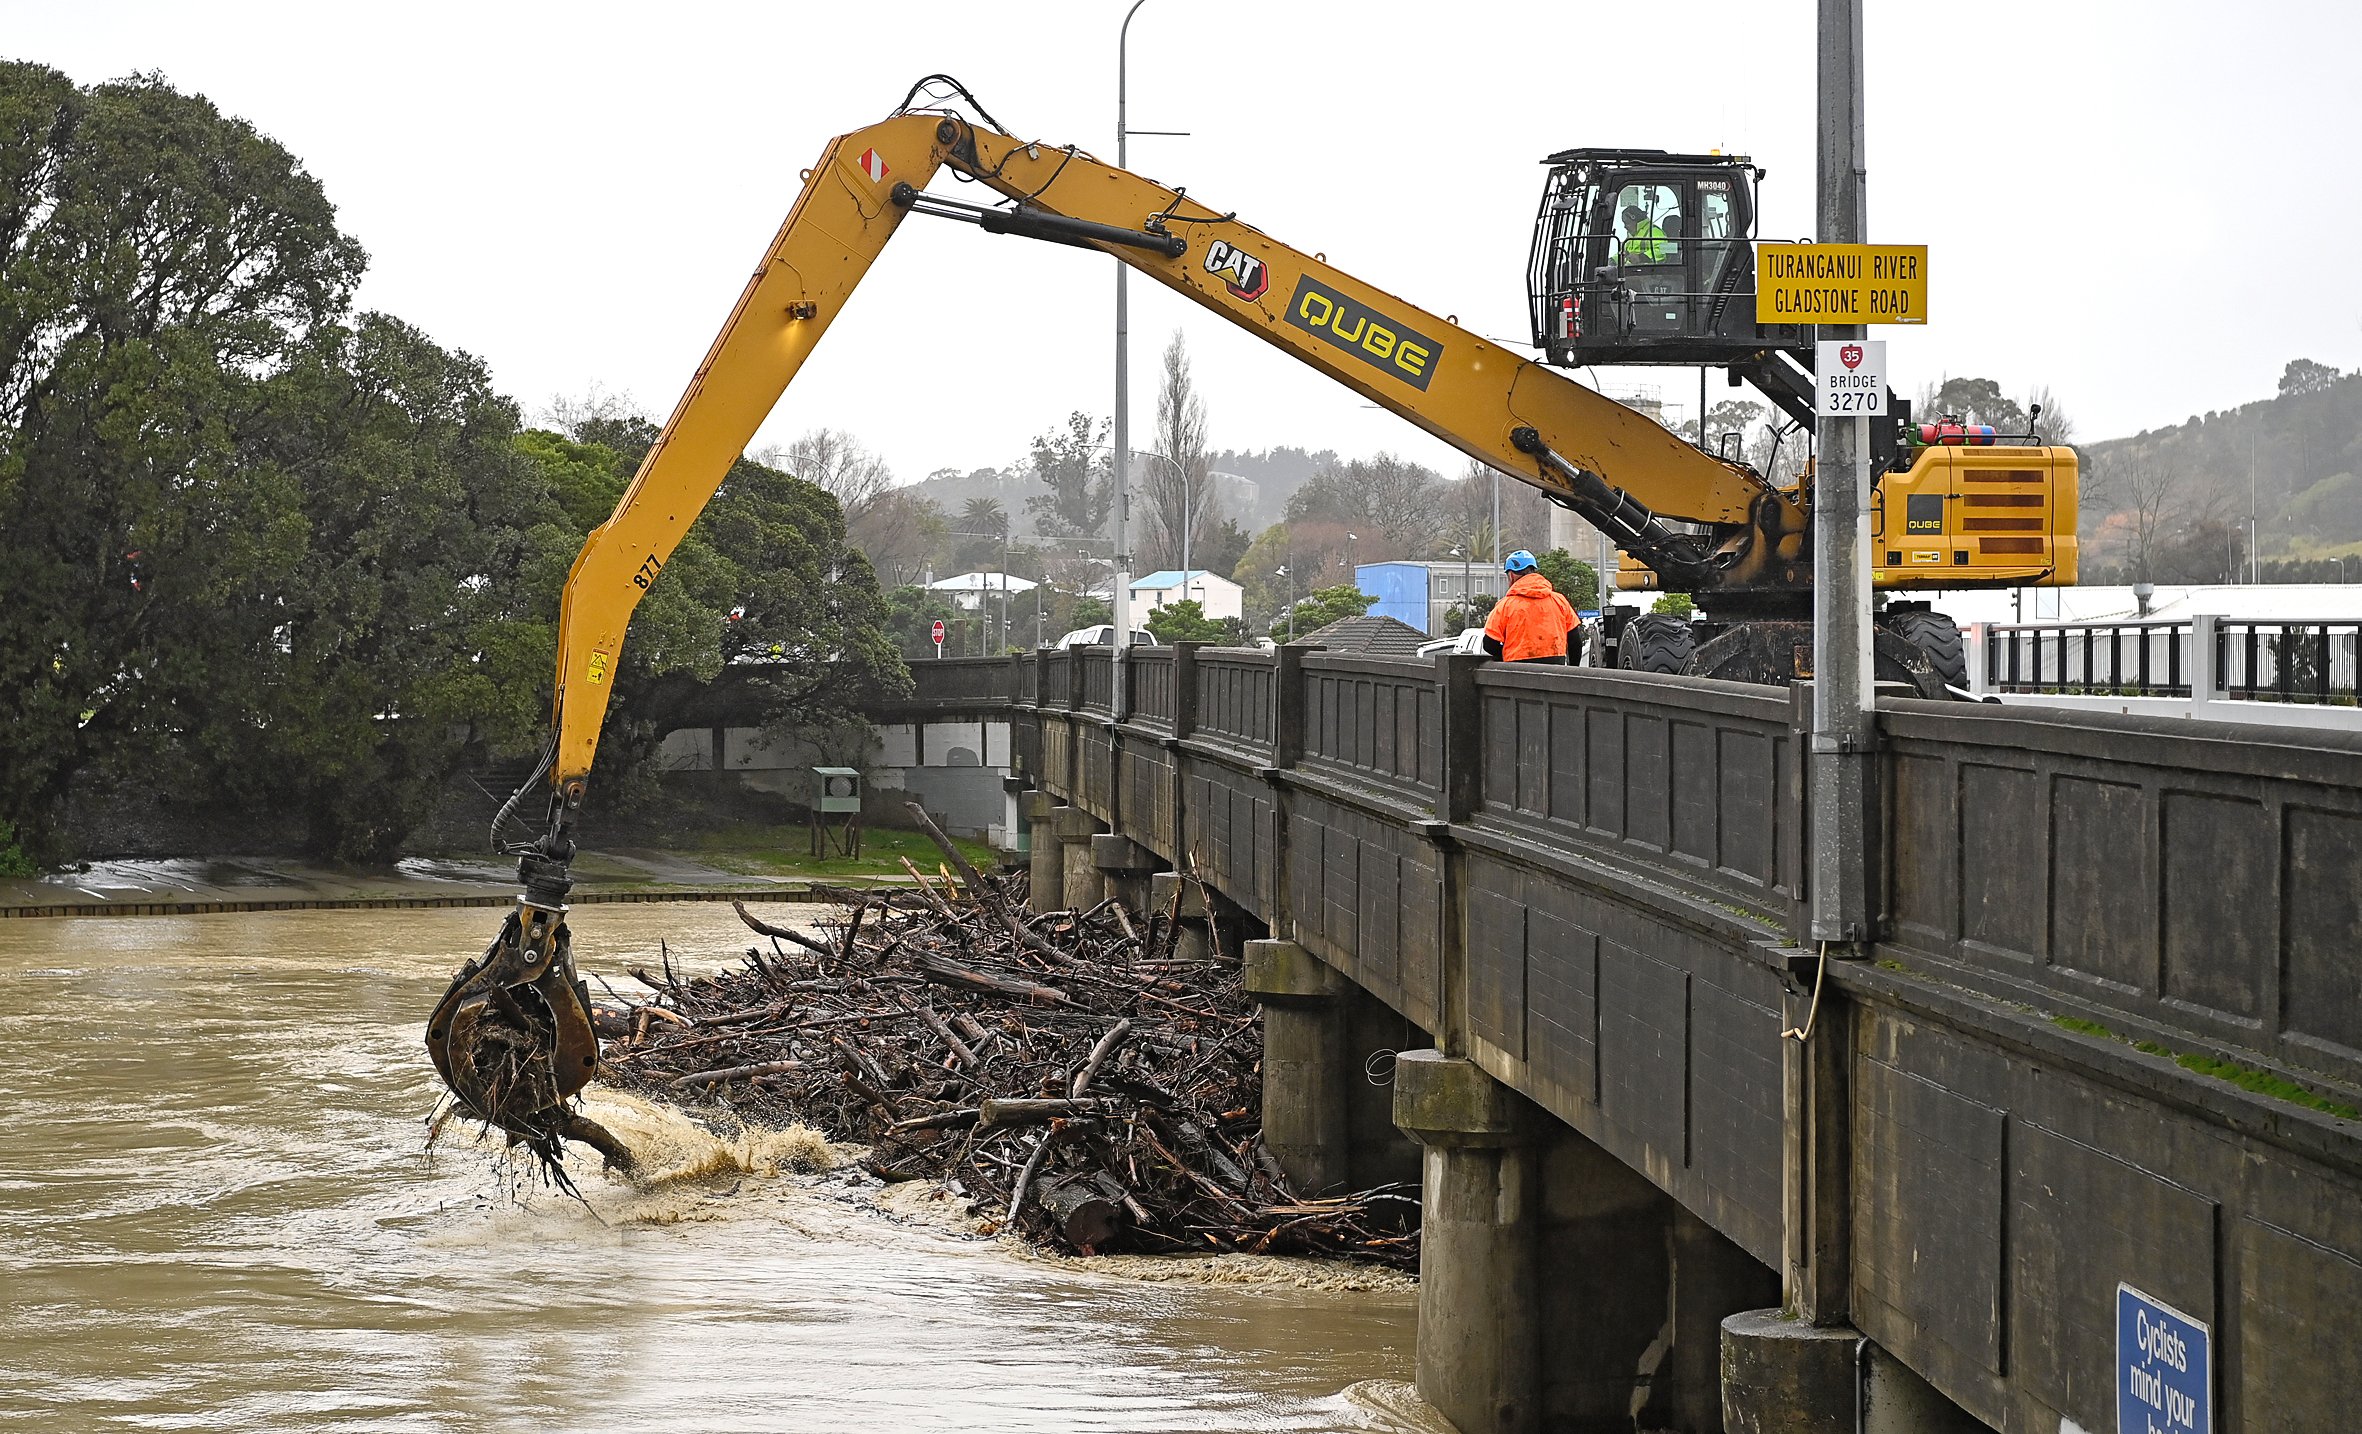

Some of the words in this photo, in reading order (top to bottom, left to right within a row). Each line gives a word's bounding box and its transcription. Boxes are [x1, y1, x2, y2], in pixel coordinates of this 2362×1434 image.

[1697, 181, 1727, 190] MH3040
[1204, 240, 1260, 288] CAT
[1767, 254, 1862, 279] TURANGANUI
[1873, 255, 1917, 280] RIVER
[1775, 288, 1859, 313] GLADSTONE
[1870, 289, 1909, 314] ROAD
[1300, 291, 1429, 376] QUBE
[1844, 350, 1860, 362] 35
[1830, 375, 1877, 388] BRIDGE
[1829, 392, 1878, 411] 3270
[1908, 520, 1941, 529] QUBE
[633, 553, 662, 589] 877
[932, 628, 944, 637] STOP
[2136, 1308, 2187, 1373] Cyclists
[2130, 1361, 2162, 1411] mind
[2165, 1384, 2196, 1429] your
